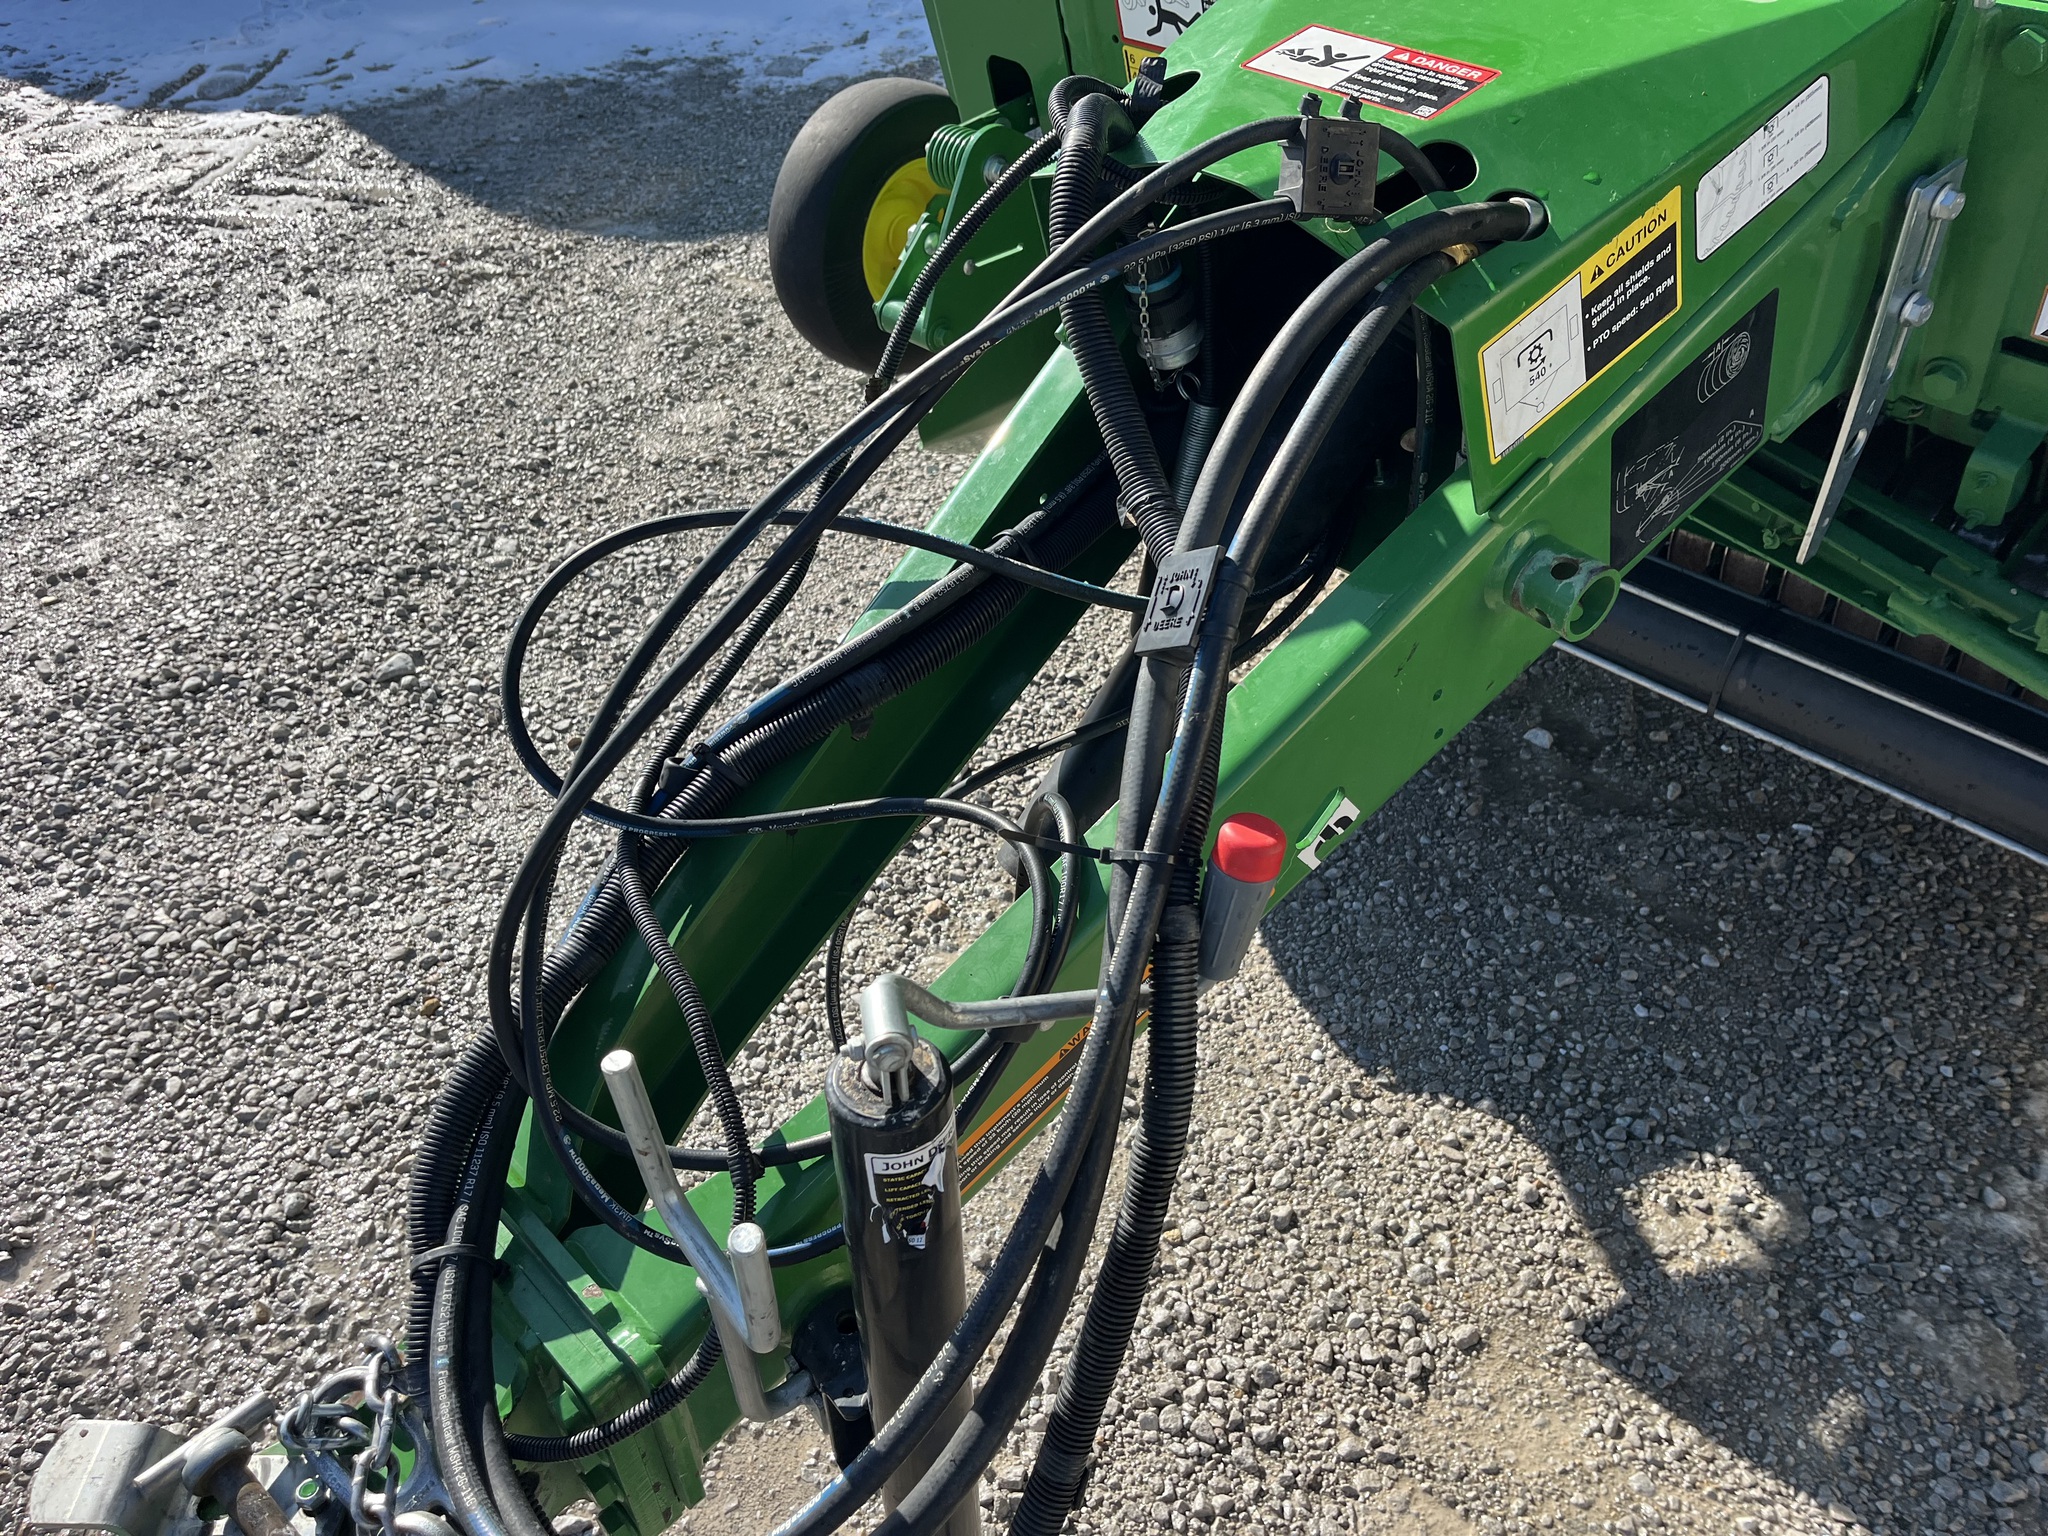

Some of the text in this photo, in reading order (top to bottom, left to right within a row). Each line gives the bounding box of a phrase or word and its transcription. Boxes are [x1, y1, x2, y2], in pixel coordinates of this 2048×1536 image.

[1130, 54, 1136, 64] 6
[1364, 65, 1387, 75] injury
[1411, 56, 1483, 80] DANGER
[1351, 73, 1372, 82] Keep
[1380, 81, 1409, 92] shields
[1371, 62, 1402, 73] driveline
[1416, 75, 1441, 83] cause
[1440, 80, 1469, 91] serious
[1435, 74, 1466, 84] rotating
[1331, 85, 1362, 97] rotating
[1338, 81, 1405, 103] Avoid contact with
[1606, 209, 1667, 268] CAUTION
[1123, 257, 1144, 273] 225
[1146, 250, 1167, 263] MPa
[1168, 237, 1197, 254] (3250
[1591, 243, 1672, 315] Keep all shields and
[1591, 275, 1651, 328] guard in place.
[1593, 330, 1610, 349] PTO
[1611, 307, 1639, 334] speed:
[1639, 292, 1654, 310] 540
[1656, 275, 1675, 296] RPM
[1529, 366, 1547, 386] 540
[913, 602, 921, 612] B
[1153, 617, 1184, 632] DEERE
[821, 650, 845, 670] MSHA
[588, 813, 627, 831] POWERING
[1108, 944, 1120, 975] lame
[549, 1099, 563, 1122] 22.5
[973, 1137, 986, 1149] this
[985, 1103, 1021, 1138] implement's
[1021, 1075, 1050, 1104] maximum
[973, 1154, 983, 1167] this
[983, 1137, 1002, 1156] speed
[1001, 1124, 1014, 1139] may
[1014, 1108, 1032, 1126] result
[1031, 1101, 1038, 1110] in
[1037, 1090, 1051, 1102] loss
[1050, 1081, 1058, 1090] of
[1057, 1062, 1078, 1083] control
[478, 1129, 490, 1147] ISO
[963, 1146, 982, 1166] speed
[981, 1140, 989, 1149] of
[988, 1133, 996, 1142] 32
[996, 1117, 1012, 1134] km/h
[1011, 1108, 1022, 1120] (20
[970, 1165, 978, 1174] or
[978, 1145, 1001, 1166] braking
[1000, 1132, 1012, 1145] and
[1012, 1112, 1034, 1134] serious
[1033, 1095, 1051, 1113] injury
[1050, 1088, 1058, 1096] or
[469, 1147, 485, 1177] 11237
[881, 1154, 924, 1172] JOHN
[568, 1148, 611, 1203] Mega3000™
[463, 1178, 476, 1197] R17
[886, 1192, 920, 1203] RETRACTED
[455, 1205, 469, 1223] SAE
[444, 1269, 456, 1286] ISO
[439, 1287, 453, 1320] 18752
[436, 1320, 450, 1343] Type
[438, 1344, 448, 1352] B
[438, 1370, 449, 1401] Flame
[440, 1401, 456, 1447] Resistant
[877, 1419, 896, 1440] MPa
[447, 1445, 464, 1475] MSHA
